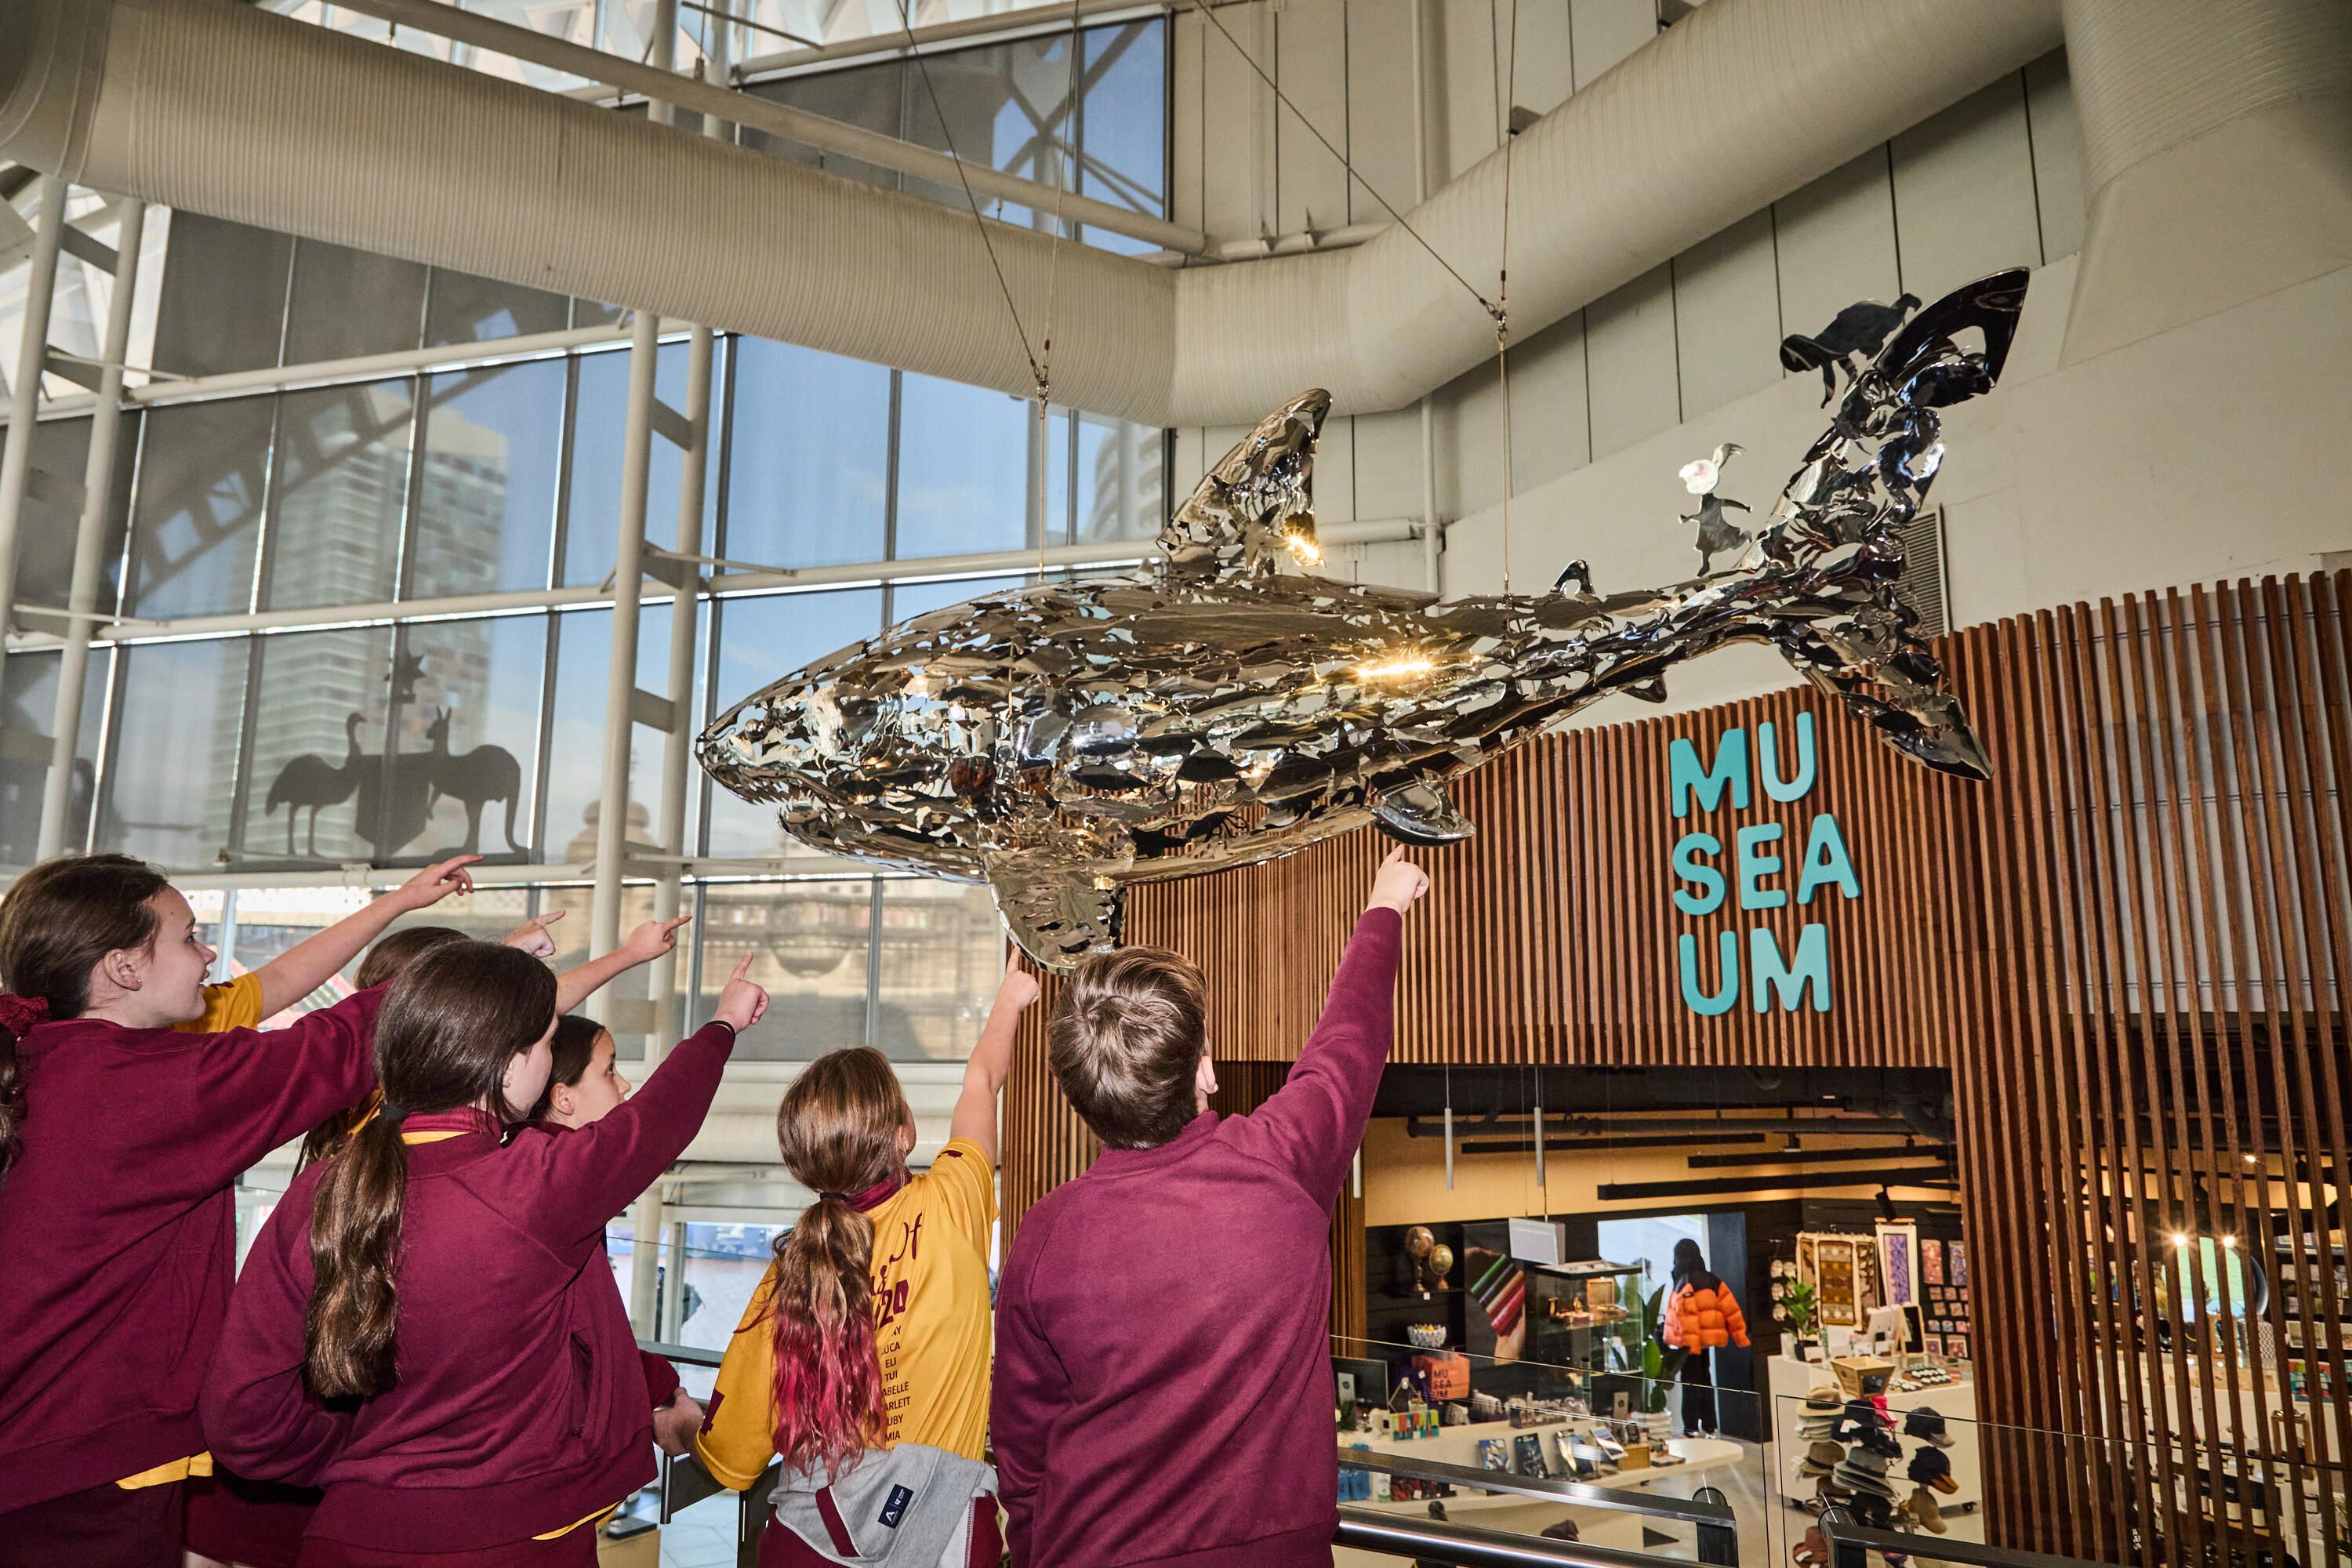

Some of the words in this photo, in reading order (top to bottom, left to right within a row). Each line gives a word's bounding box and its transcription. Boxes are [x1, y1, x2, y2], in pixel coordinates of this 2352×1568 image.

[1669, 711, 1818, 818] MU
[1672, 813, 1862, 916] SEA
[1679, 923, 1833, 1016] UM
[885, 1356, 897, 1369] ELI
[884, 1370, 898, 1381] TUI
[887, 1413, 904, 1426] UBY
[885, 1430, 901, 1442] MIA
